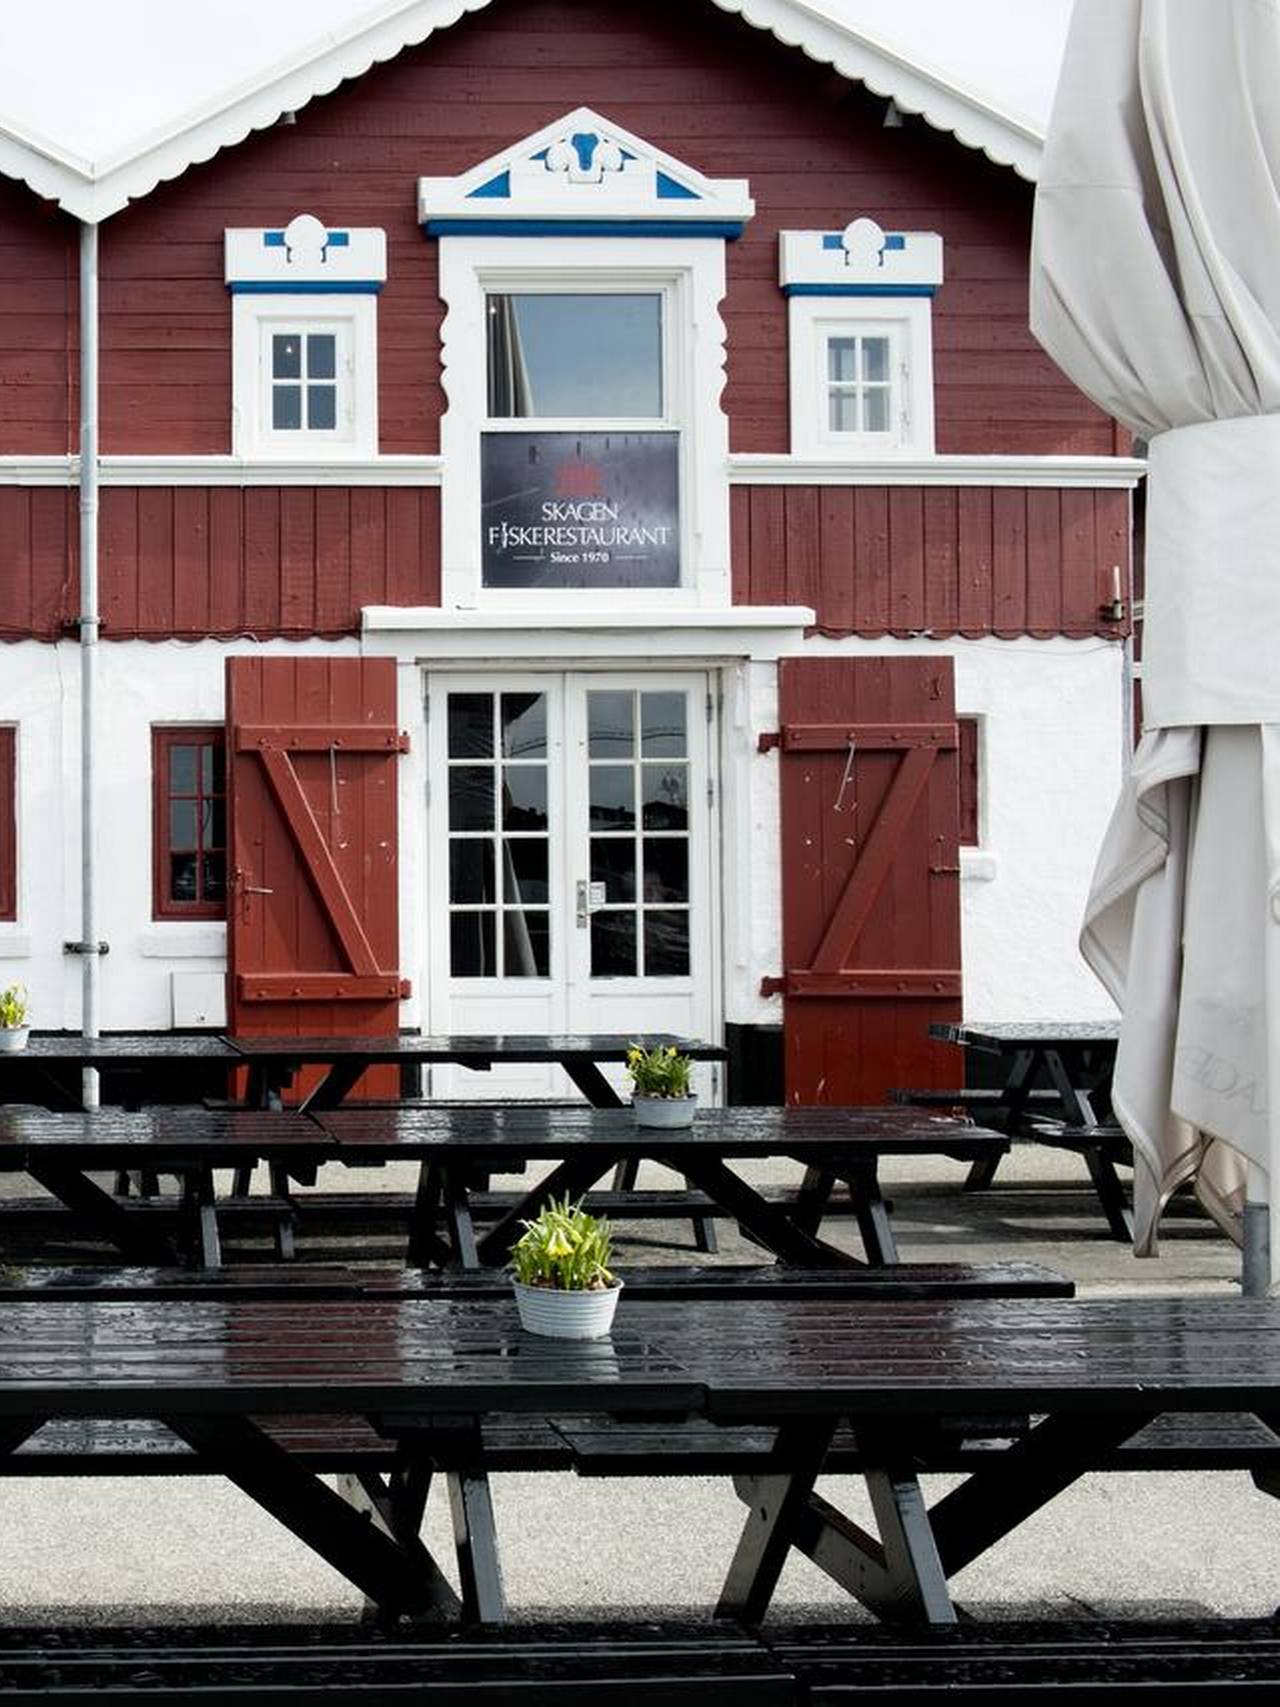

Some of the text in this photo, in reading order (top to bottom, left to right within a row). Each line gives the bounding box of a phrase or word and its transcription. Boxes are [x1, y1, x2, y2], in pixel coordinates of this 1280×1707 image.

[541, 502, 619, 522] SKAGEN
[489, 522, 672, 548] FISKERESTAURANT
[550, 552, 610, 563] Since 1970
